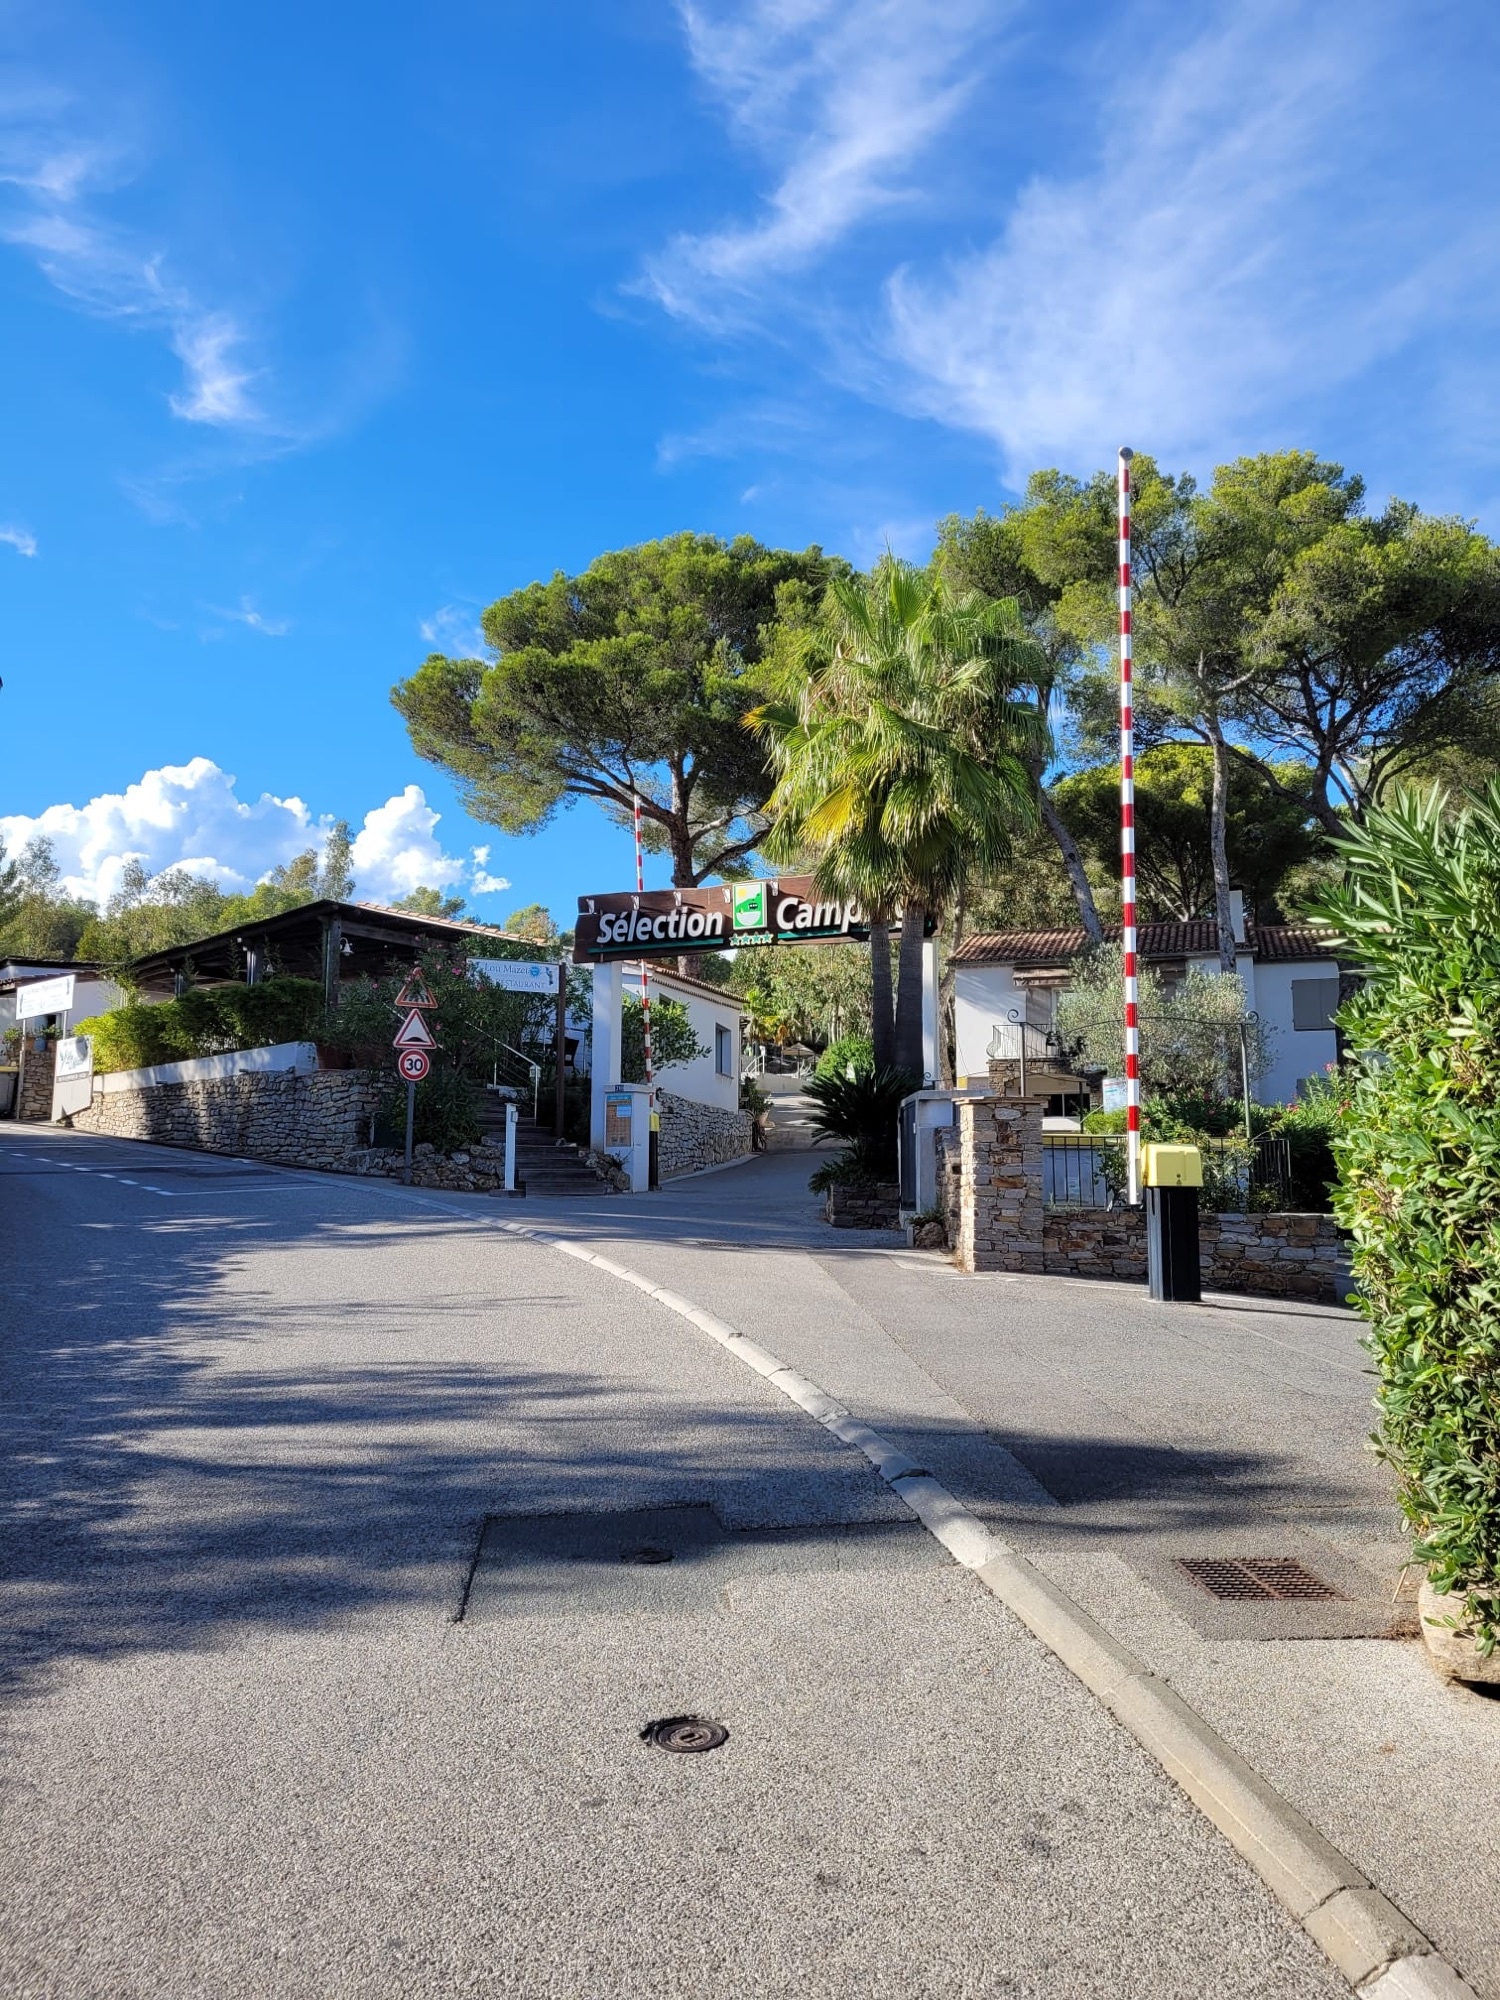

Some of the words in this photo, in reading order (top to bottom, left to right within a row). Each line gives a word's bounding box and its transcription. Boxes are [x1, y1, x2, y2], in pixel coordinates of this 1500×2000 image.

[596, 906, 724, 944] Sélection
[484, 962, 501, 973] Lou
[405, 1058, 424, 1072] 30
